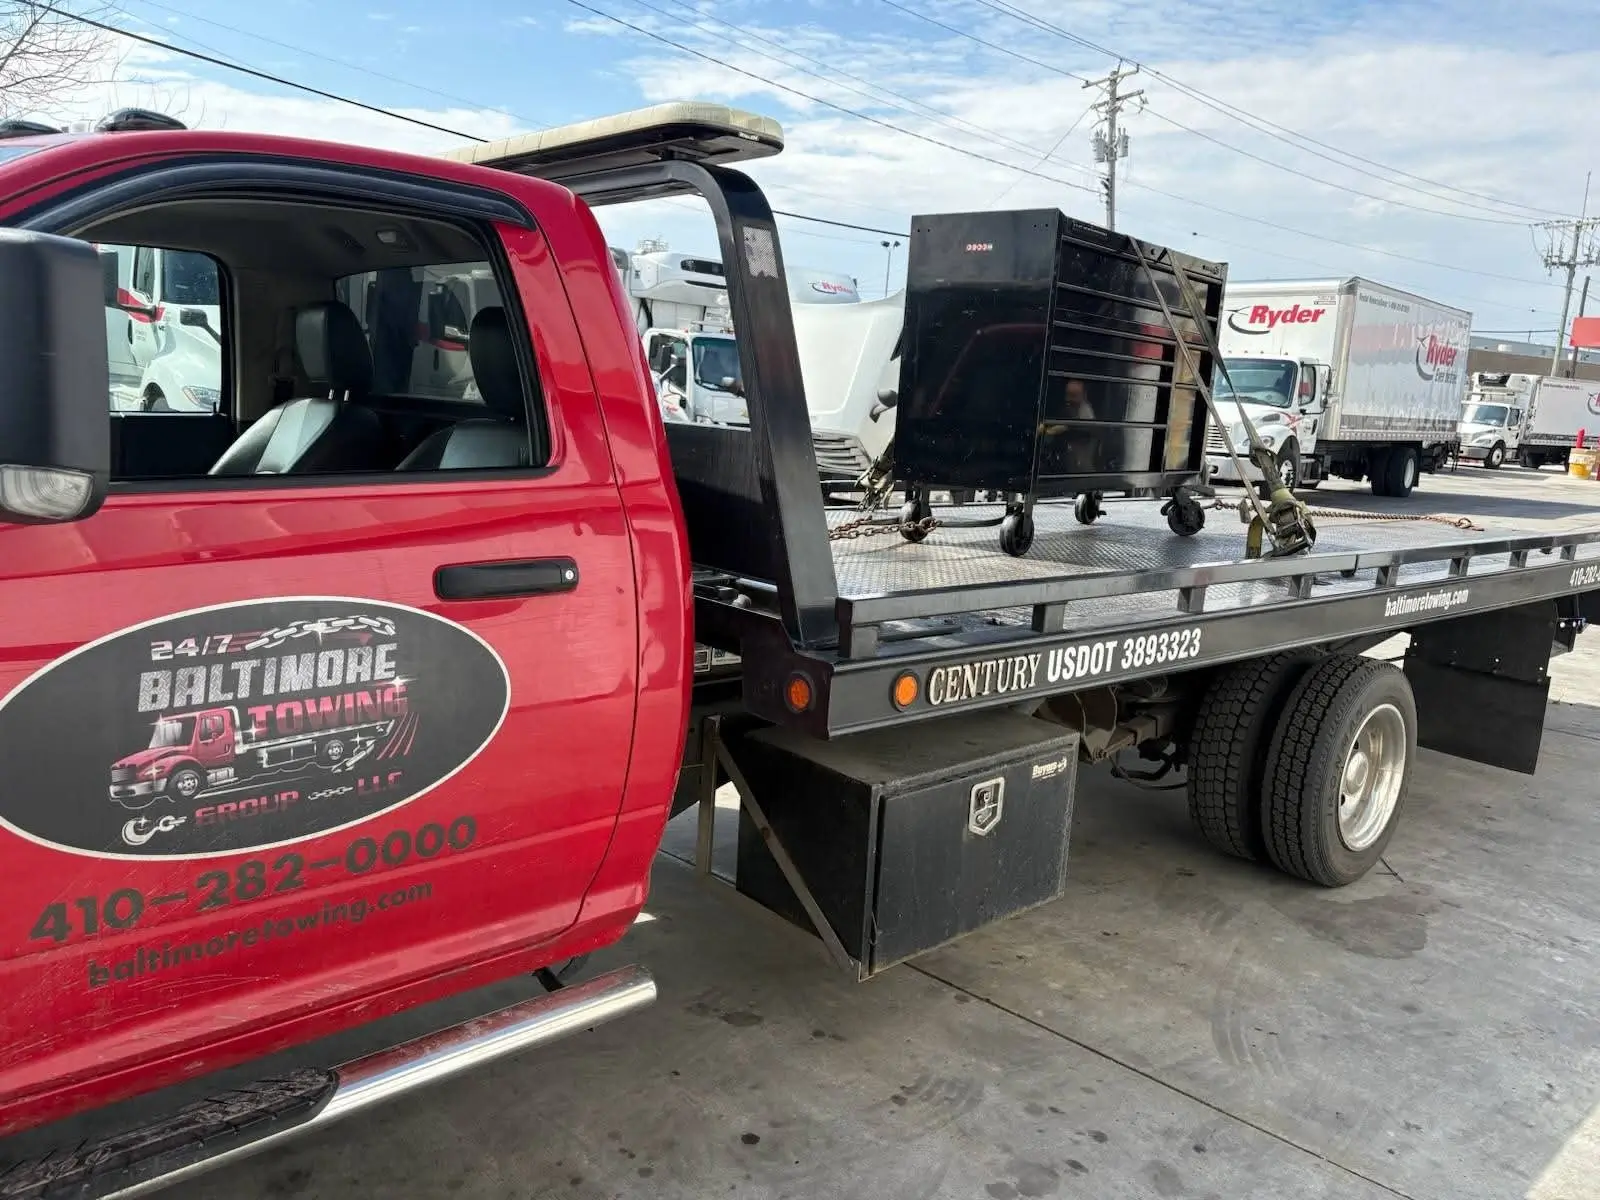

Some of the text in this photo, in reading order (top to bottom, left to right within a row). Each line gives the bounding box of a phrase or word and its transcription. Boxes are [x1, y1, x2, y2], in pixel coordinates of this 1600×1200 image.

[1248, 304, 1326, 328] Ryder
[1426, 334, 1458, 372] Ryder
[1384, 588, 1470, 617] baltimoretowing.com
[1569, 564, 1600, 587] 410-282-
[151, 634, 233, 661] 24/7
[928, 627, 1202, 706] CENTURY USDOT 3893323
[137, 643, 398, 713] BALTIMORE
[247, 684, 409, 738] TOWING
[195, 771, 403, 827] GROUP LLC
[28, 815, 478, 943] 410-282-0000
[88, 881, 434, 990] baltimoretowing.com
